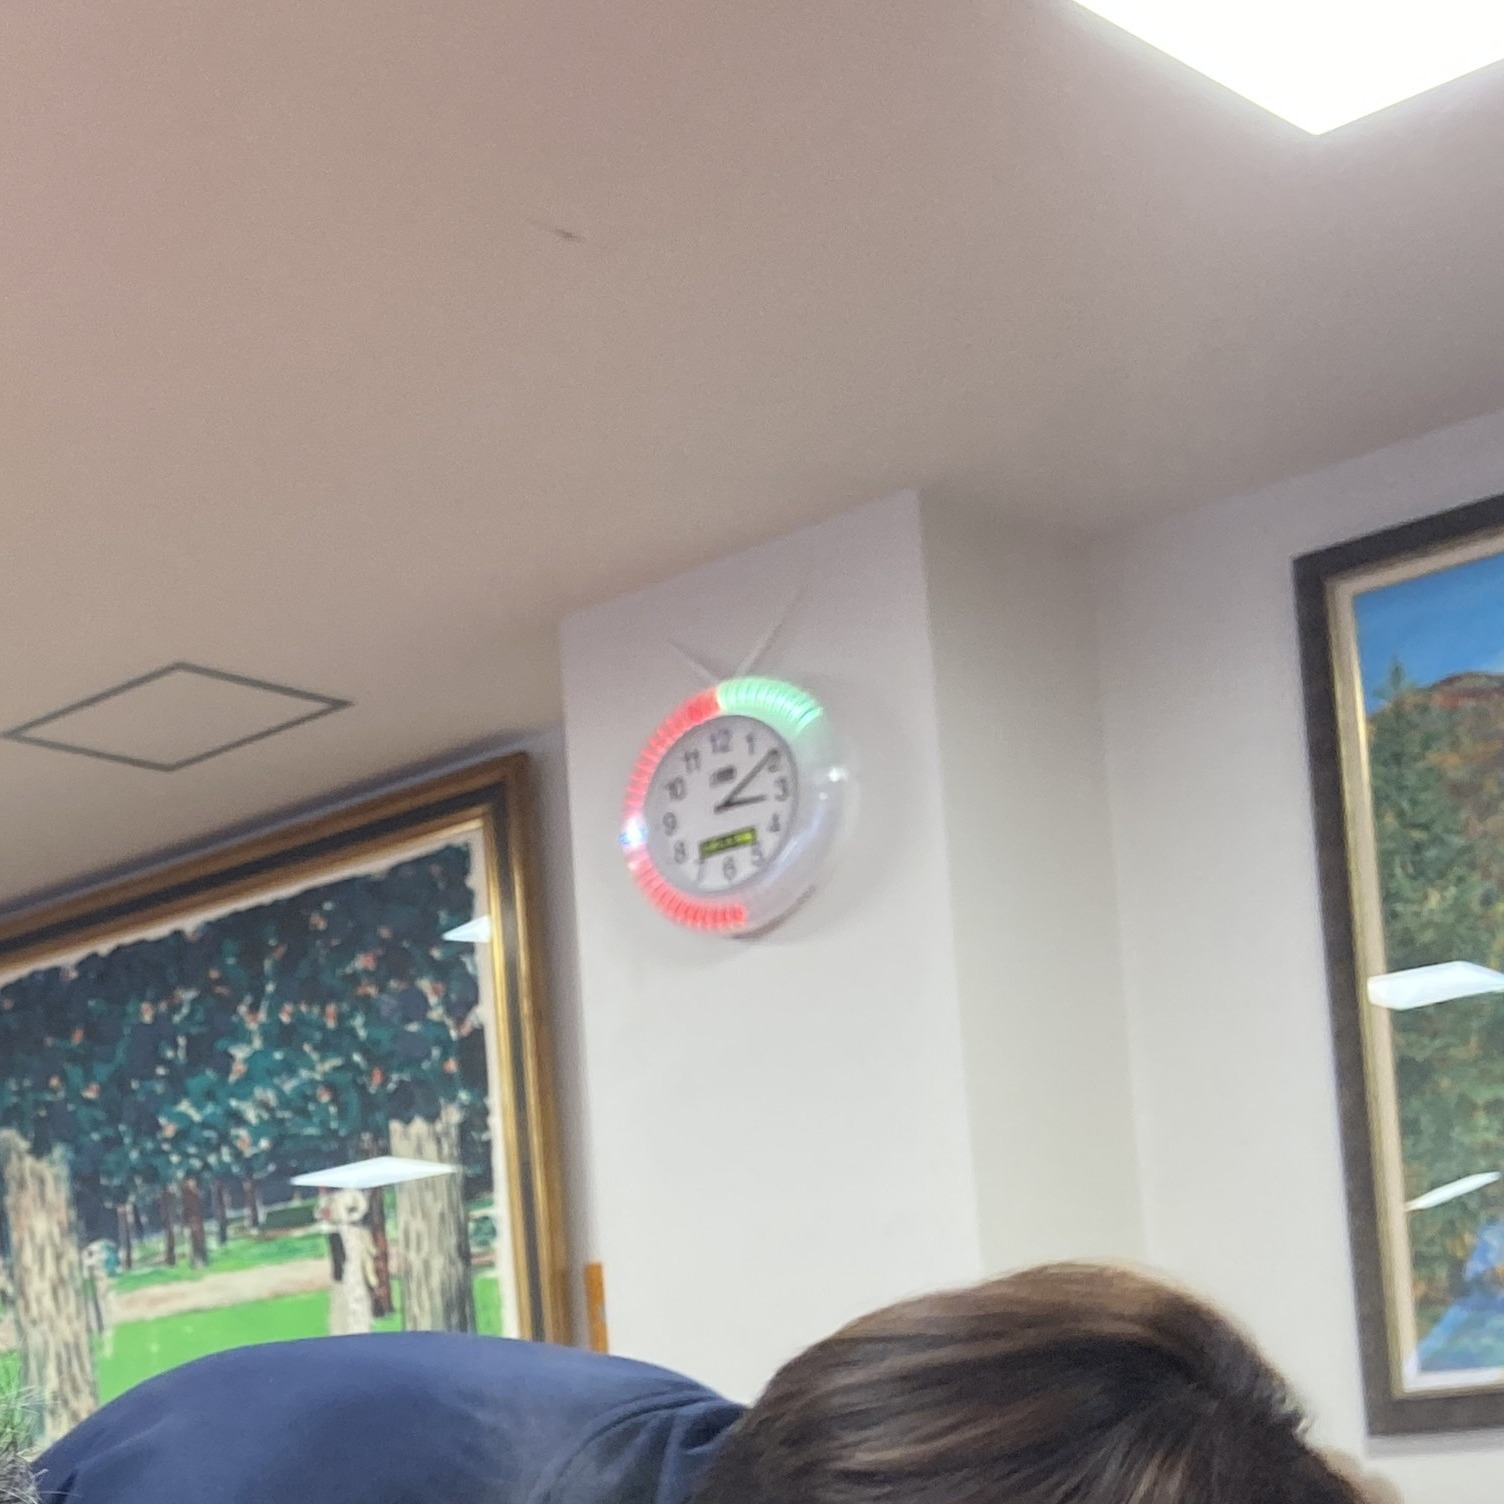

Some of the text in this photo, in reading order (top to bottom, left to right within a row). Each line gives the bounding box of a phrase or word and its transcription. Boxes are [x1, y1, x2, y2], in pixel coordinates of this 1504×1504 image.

[709, 729, 732, 754] 12
[746, 733, 756, 755] 1
[682, 749, 702, 774] 11
[665, 776, 687, 801] 10
[774, 776, 789, 802] 3
[662, 811, 677, 837] 9
[767, 813, 781, 833] 4
[673, 841, 687, 865] 8
[722, 856, 737, 881] 6
